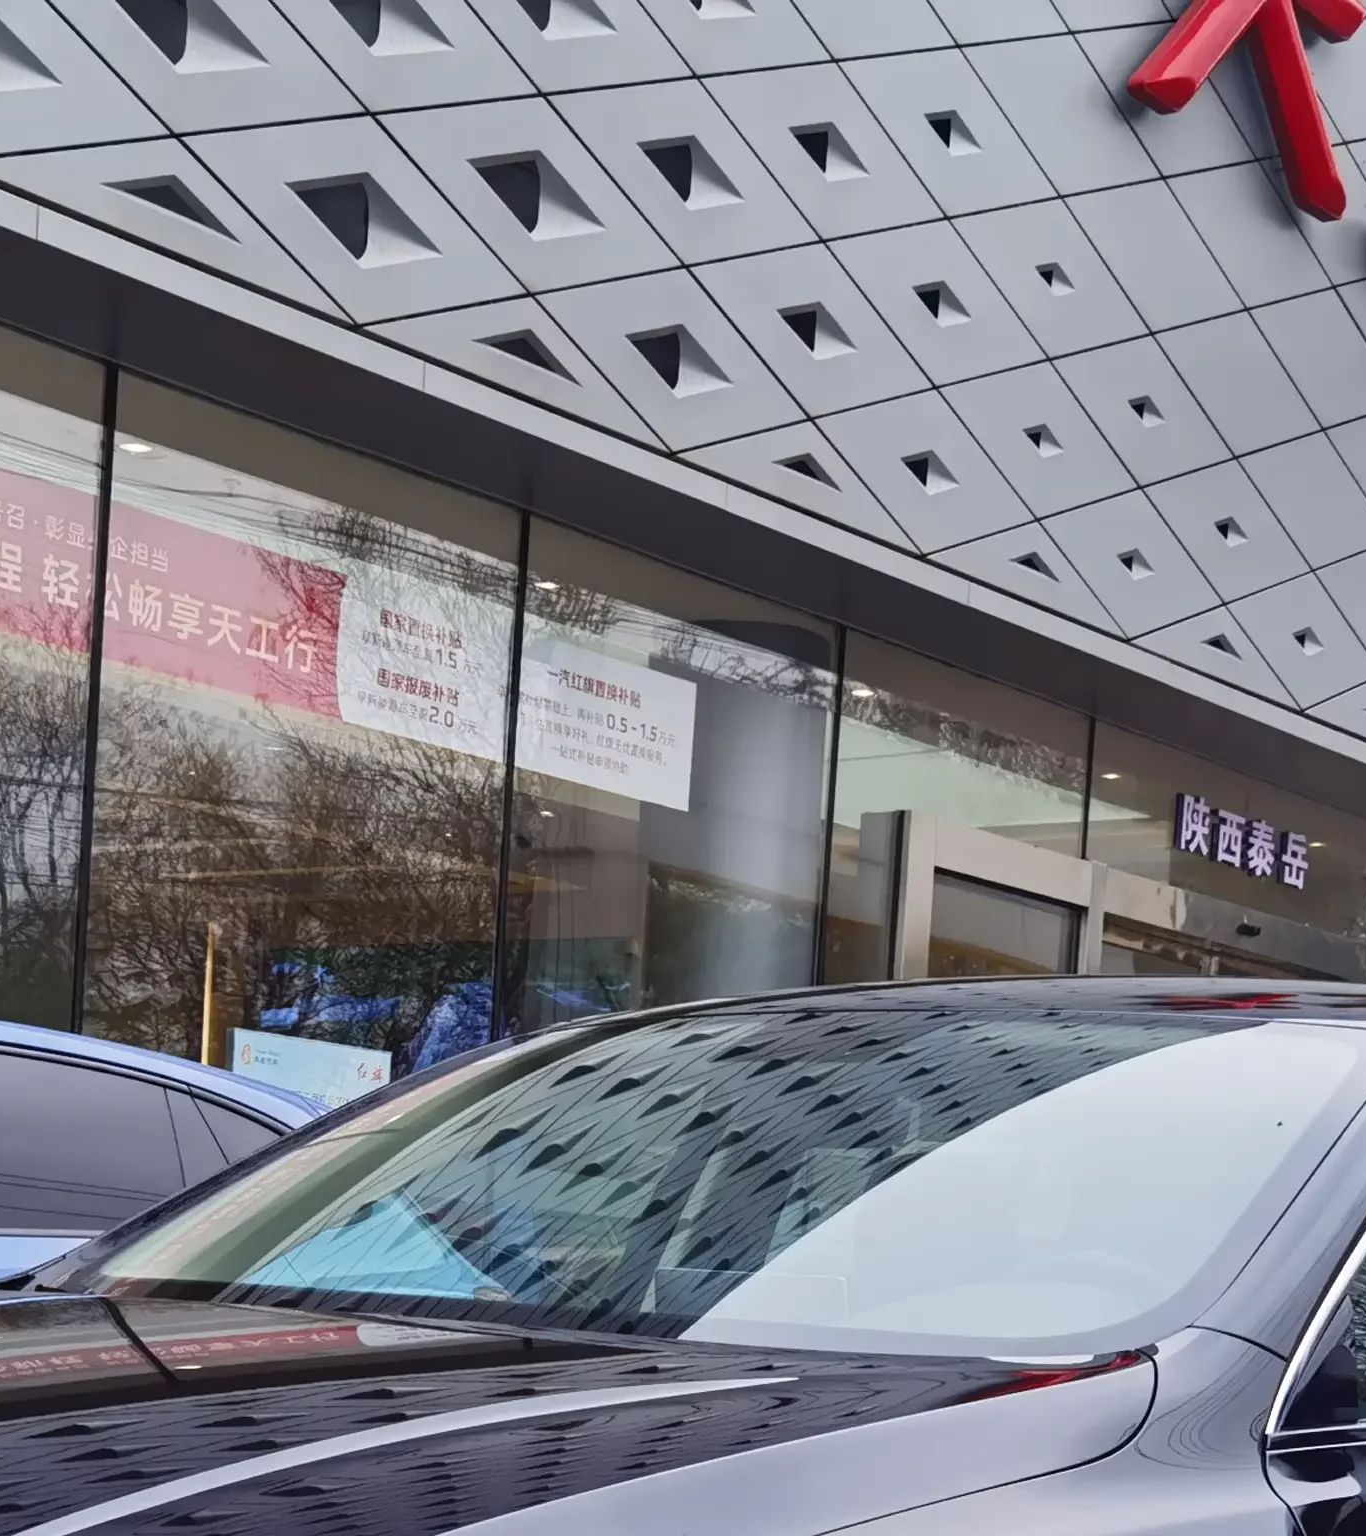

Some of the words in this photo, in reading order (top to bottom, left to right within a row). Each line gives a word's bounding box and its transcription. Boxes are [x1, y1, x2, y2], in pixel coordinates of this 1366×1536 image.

[377, 668, 459, 707] 国家报废补贴
[547, 669, 641, 708] 一汽红旗置换补贴
[1179, 794, 1309, 890] 陕西泰岳
